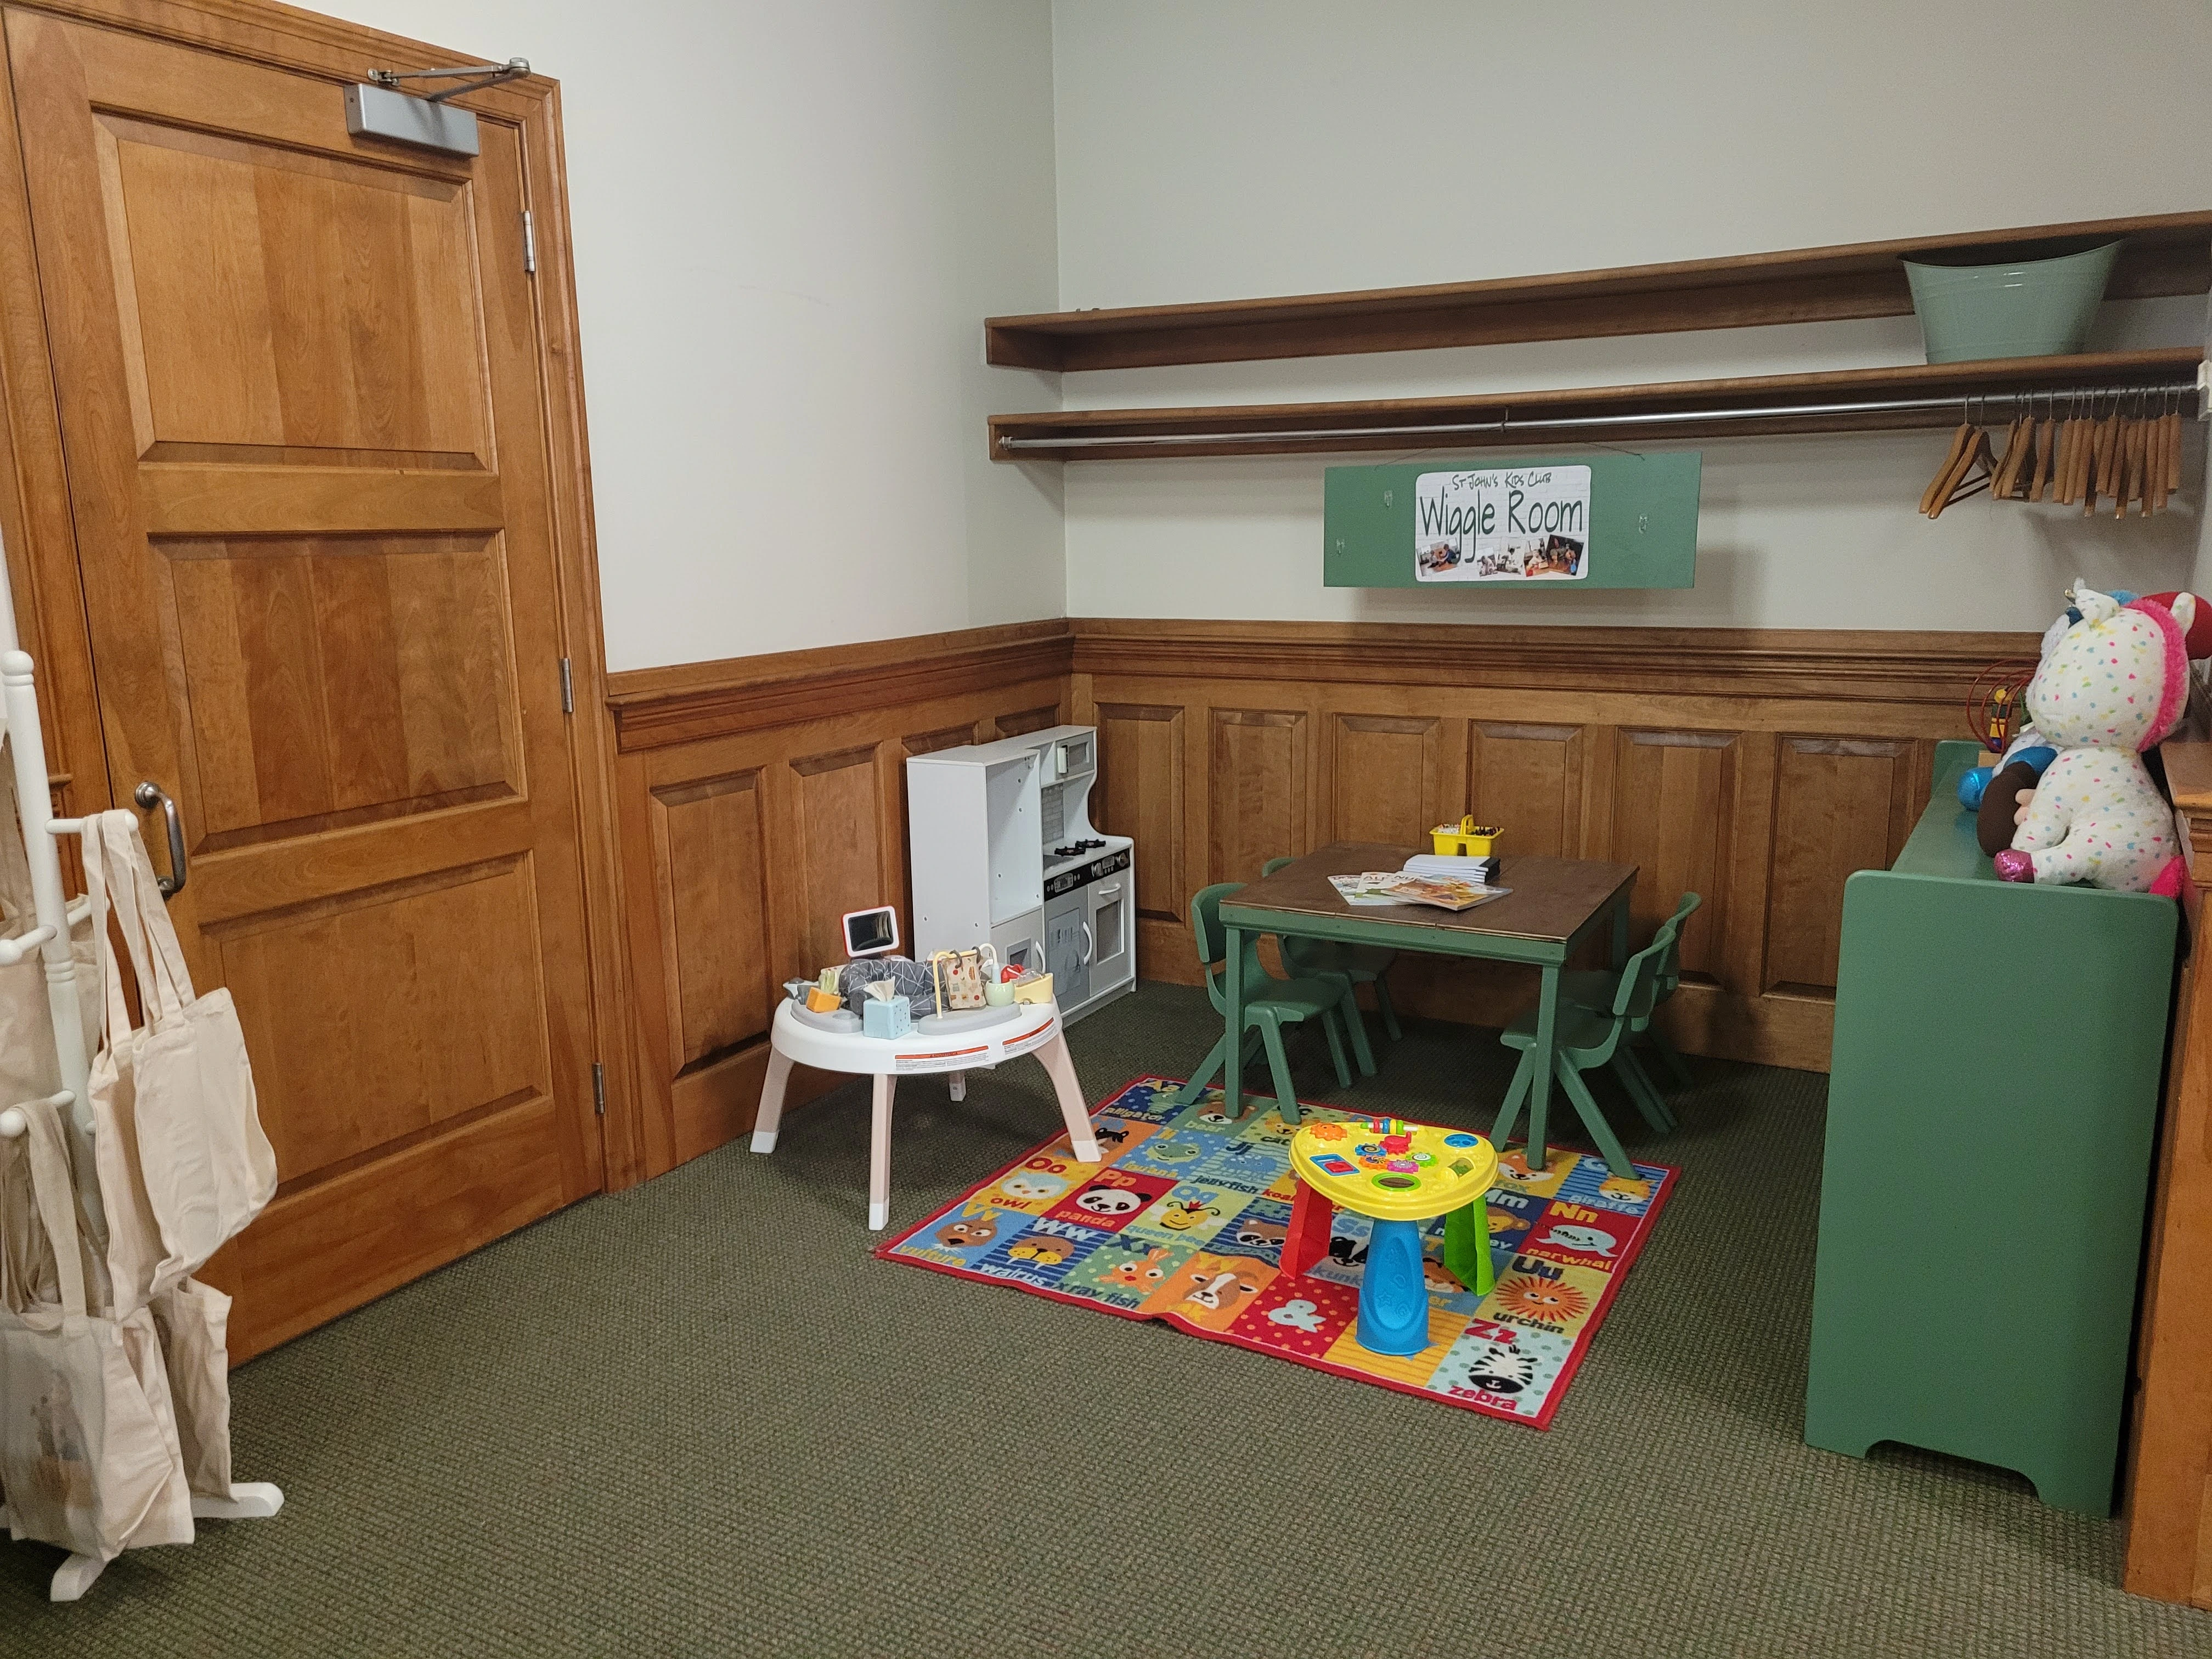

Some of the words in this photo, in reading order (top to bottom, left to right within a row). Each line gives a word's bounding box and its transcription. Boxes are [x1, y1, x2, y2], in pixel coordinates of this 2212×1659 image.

[1420, 486, 1496, 563] Wiggle
[1509, 489, 1582, 534] Room
[1105, 1107, 1165, 1121] alligator
[1025, 1157, 1067, 1174] Oo
[1093, 1169, 1136, 1187] Pp
[1190, 1175, 1260, 1194] jellyfish
[990, 1197, 1032, 1210] owl
[1549, 1201, 1599, 1223] Nn
[1055, 1210, 1115, 1228] panda
[900, 1245, 967, 1267] vulture
[1526, 1248, 1611, 1271] narwhal
[981, 1263, 1048, 1286] walrus
[1512, 1256, 1564, 1280] Uu
[1105, 1293, 1141, 1309] fish
[1464, 1318, 1517, 1344] Zz
[1493, 1312, 1565, 1334] urchin
[1448, 1385, 1518, 1411] zebra
